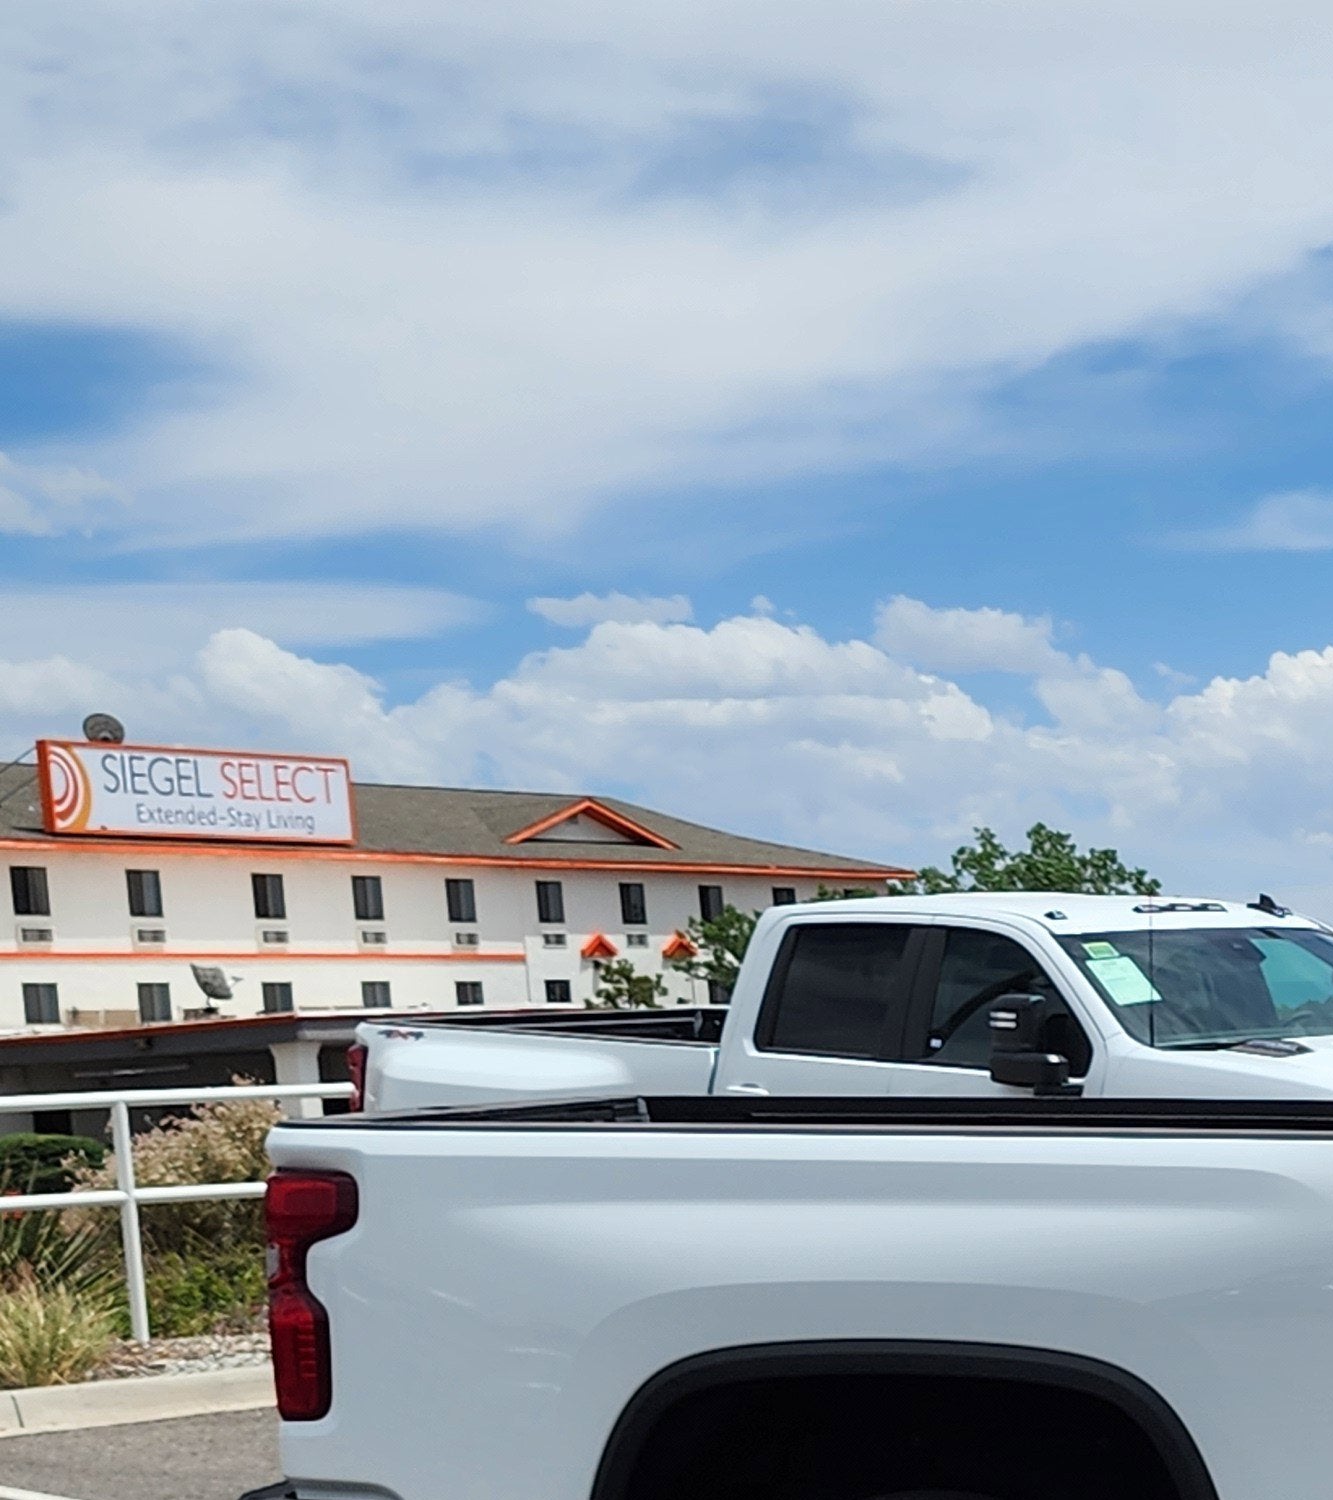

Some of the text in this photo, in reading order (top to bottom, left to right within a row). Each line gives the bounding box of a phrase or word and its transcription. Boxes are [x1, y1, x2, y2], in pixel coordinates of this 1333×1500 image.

[101, 753, 337, 804] SIEGEL SELECT
[136, 803, 316, 835] Extended-Stay Living
